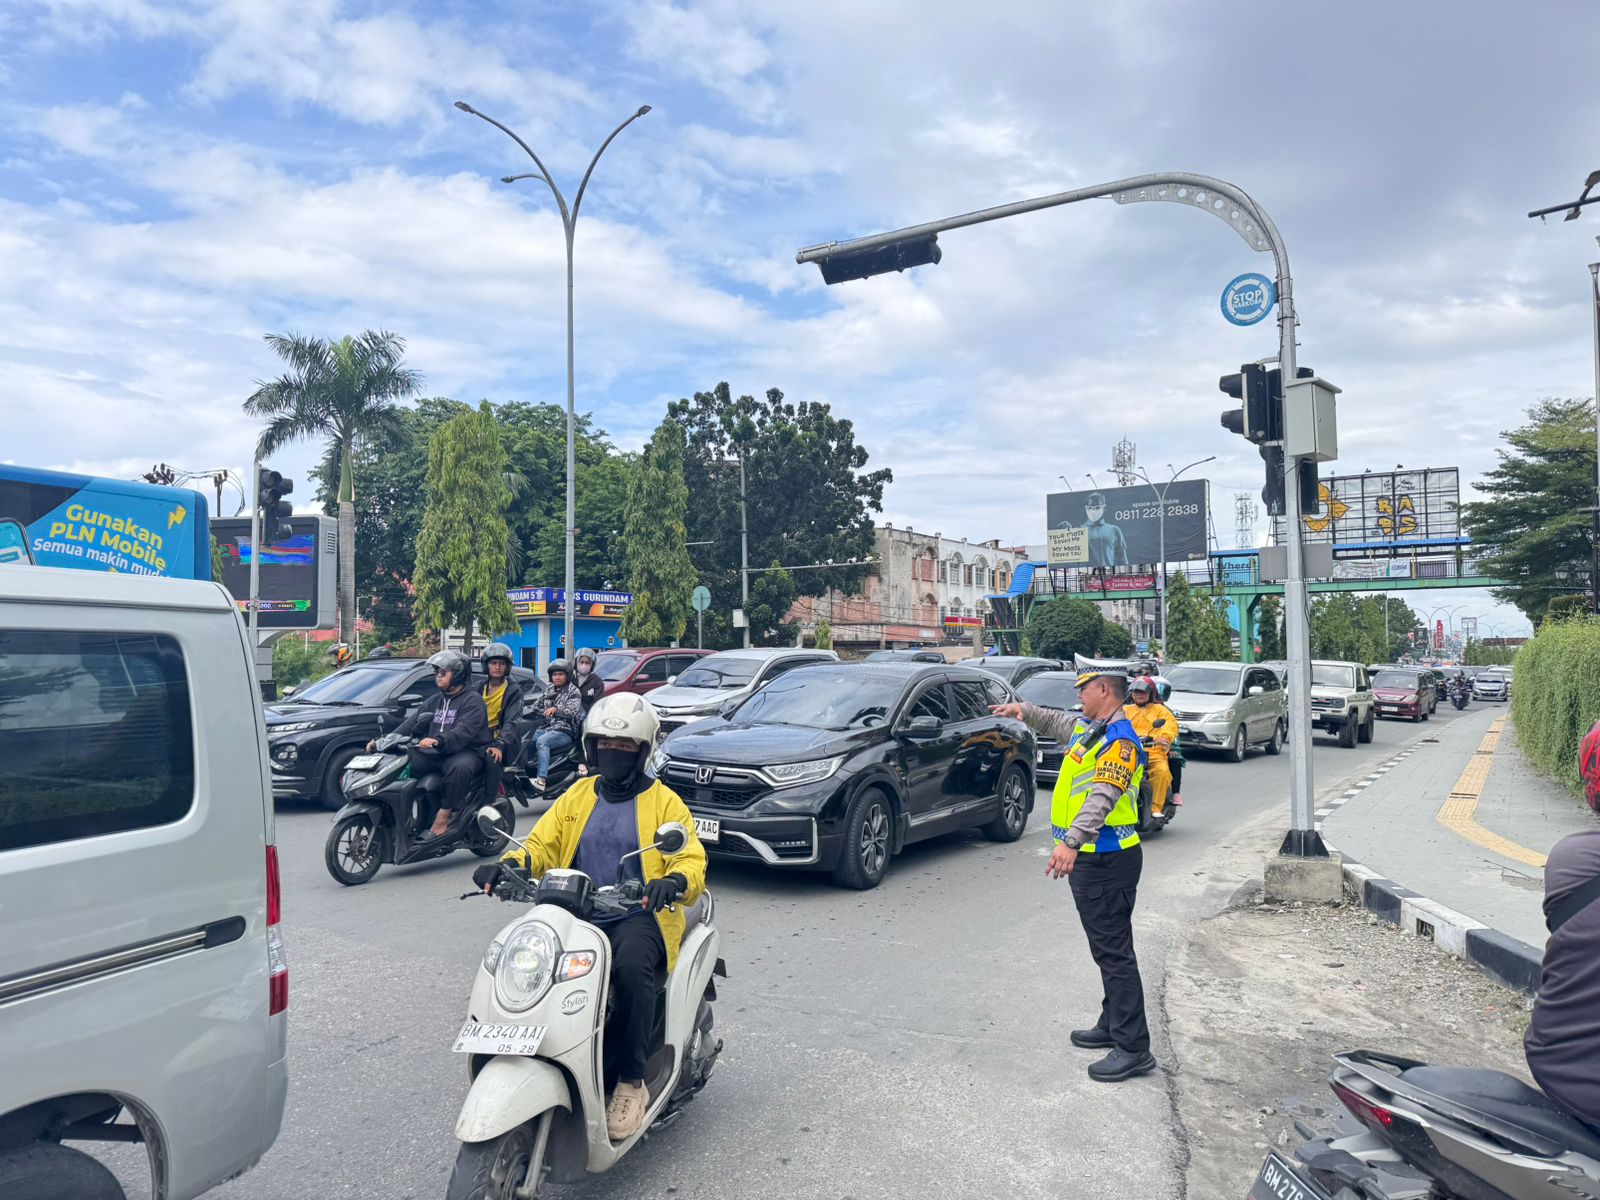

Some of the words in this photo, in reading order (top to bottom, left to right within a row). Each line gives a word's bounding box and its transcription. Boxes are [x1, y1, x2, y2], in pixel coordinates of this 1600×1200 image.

[1233, 290, 1262, 304] STOP
[1115, 510, 1140, 521] 0811
[1142, 506, 1165, 519] 228
[1167, 503, 1199, 516] 2838
[66, 504, 163, 549] Gunakan
[33, 538, 83, 557] Semua
[86, 548, 128, 569] makin
[49, 522, 96, 543] PLN
[101, 530, 166, 571] Mobile
[530, 591, 536, 600] 5
[583, 594, 629, 603] GURINDAM
[702, 820, 718, 834] AAC
[561, 994, 590, 1010] Stylish
[461, 1024, 482, 1037] BM
[483, 1025, 519, 1039] 2340
[497, 1043, 513, 1053] 05
[519, 1044, 535, 1054] 28
[1264, 1163, 1283, 1192] BM
